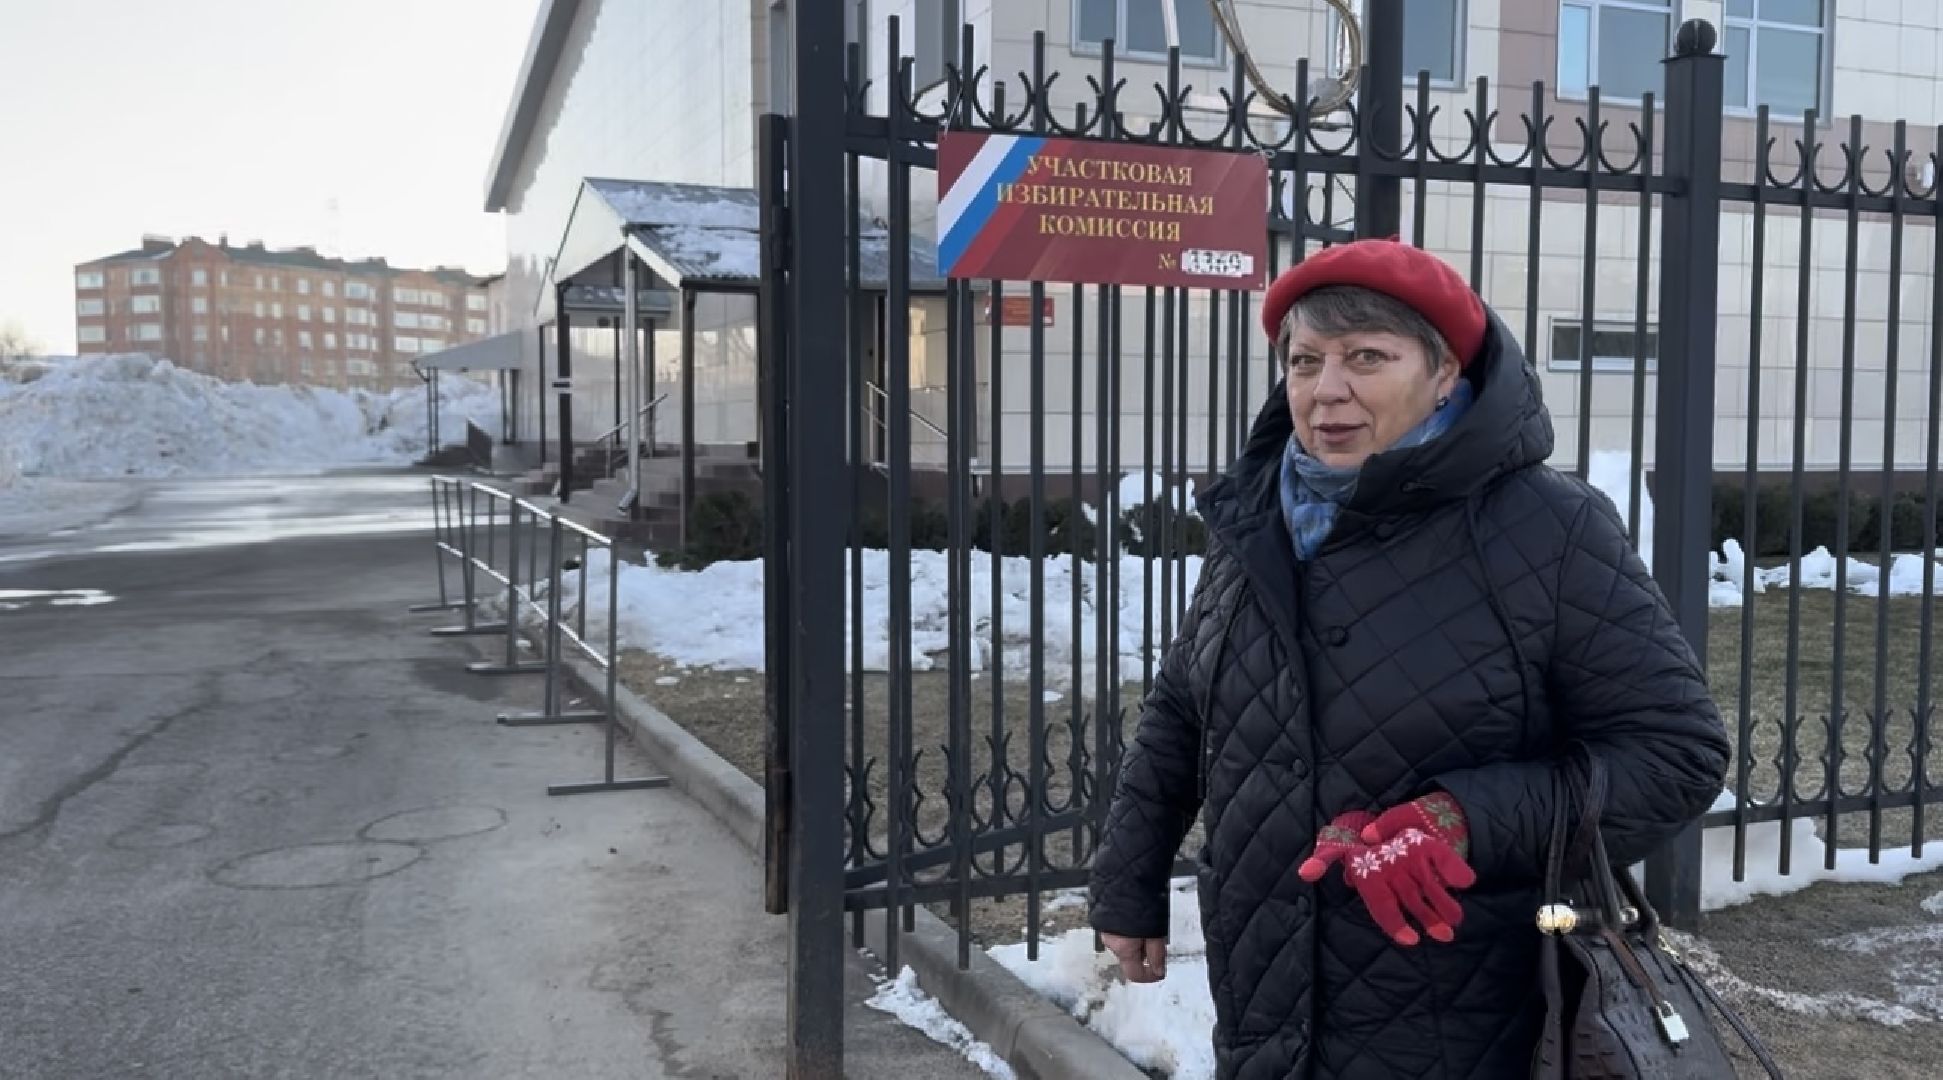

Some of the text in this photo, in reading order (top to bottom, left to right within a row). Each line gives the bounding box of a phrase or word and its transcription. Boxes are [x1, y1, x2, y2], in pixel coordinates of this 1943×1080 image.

[1027, 155, 1192, 186] УЧАСТКОВАЯ
[997, 182, 1214, 216] ИЗБИРАТЕЛЬНАЯ
[1039, 214, 1181, 242] КОМИССИЯ
